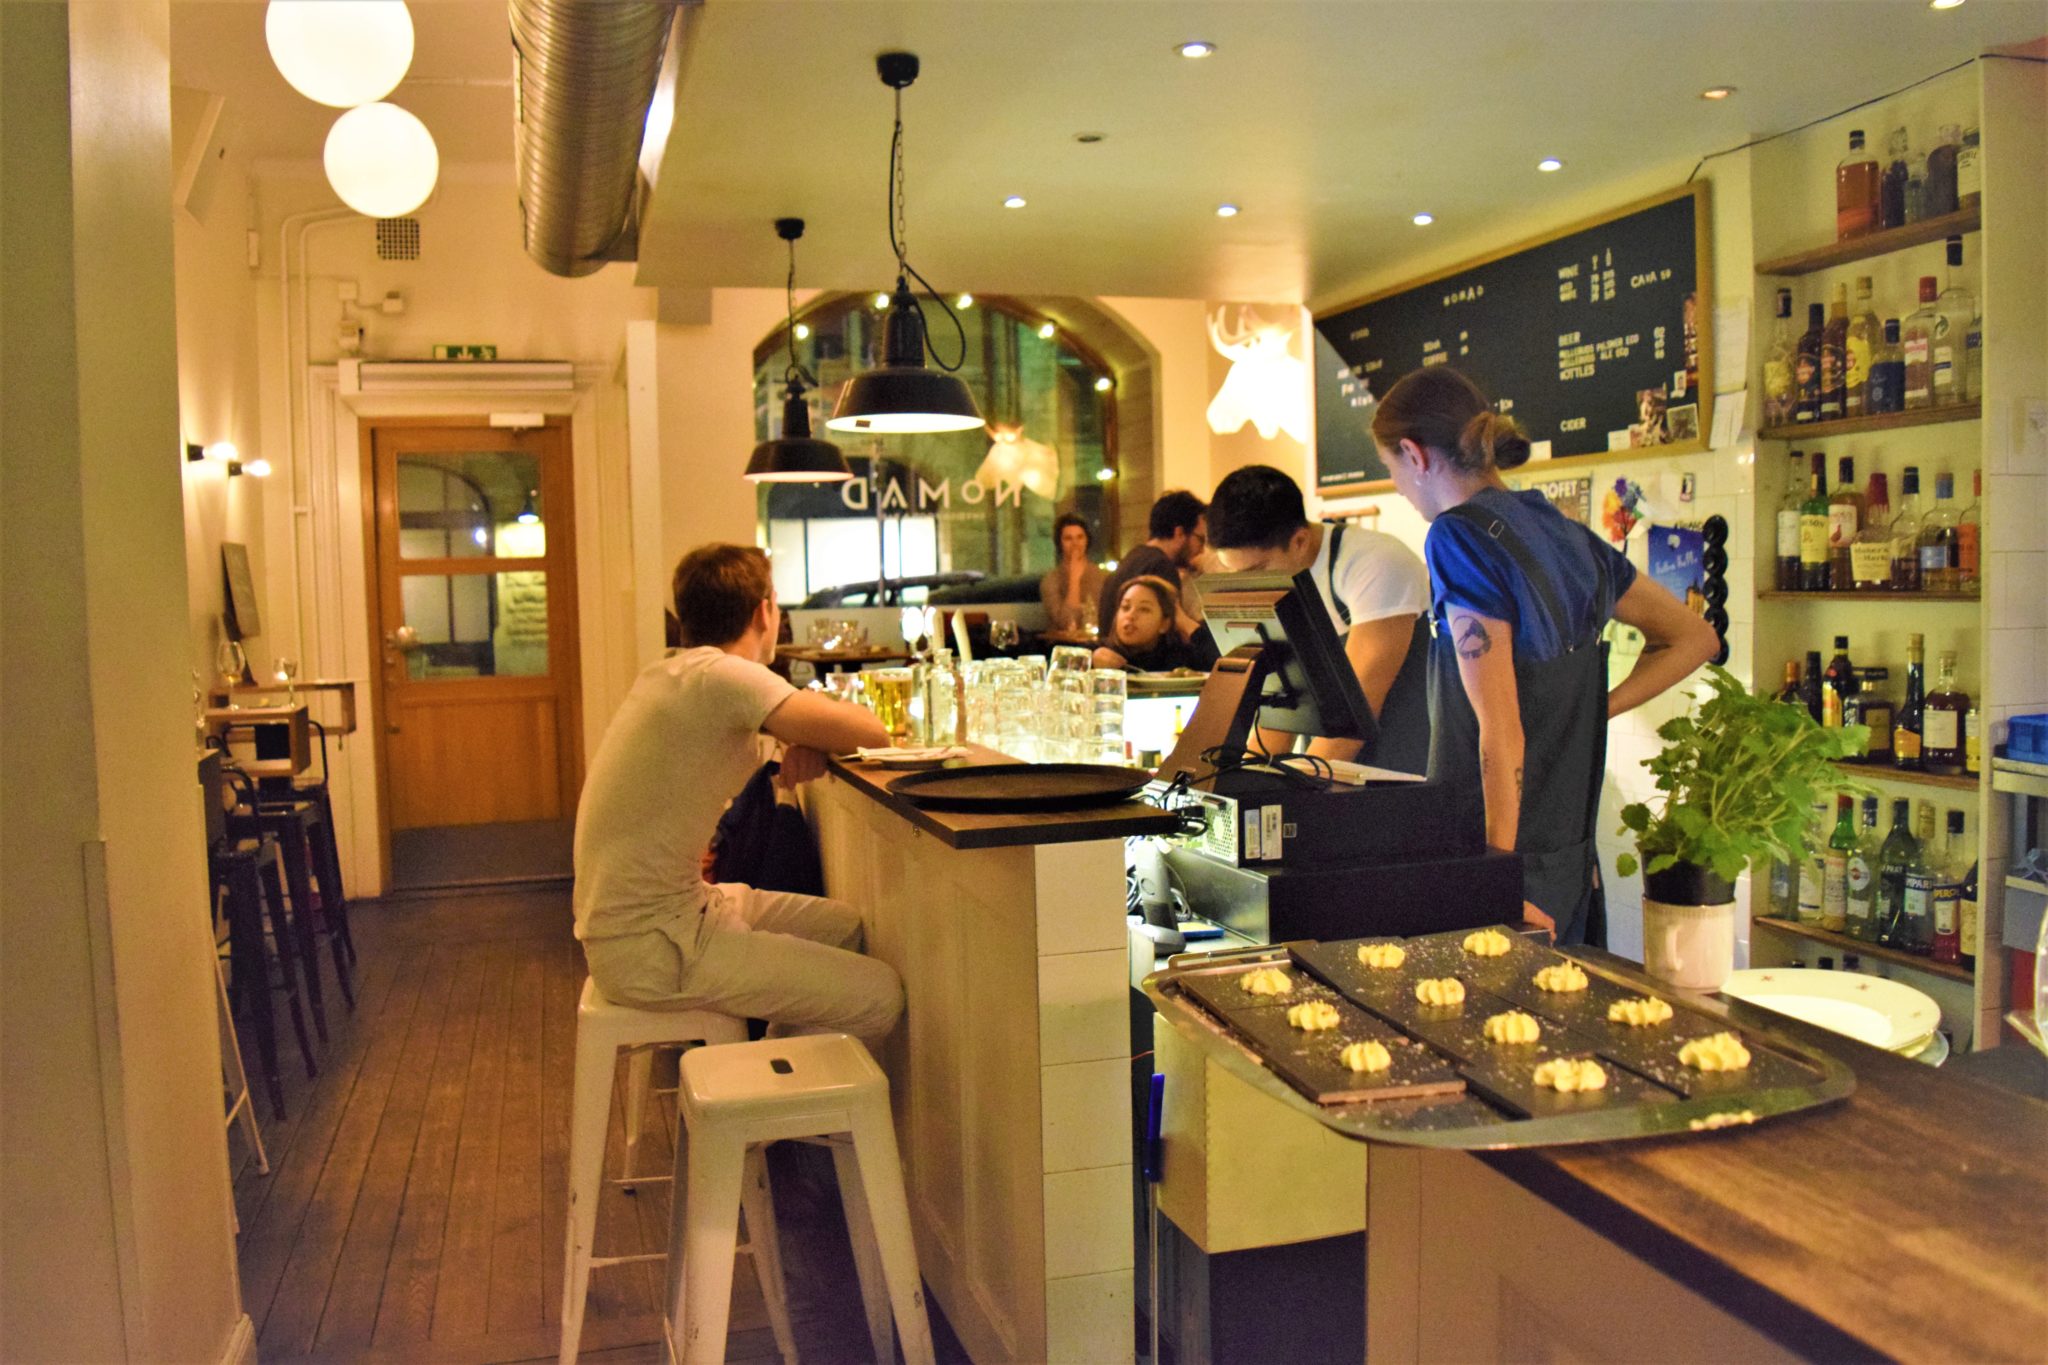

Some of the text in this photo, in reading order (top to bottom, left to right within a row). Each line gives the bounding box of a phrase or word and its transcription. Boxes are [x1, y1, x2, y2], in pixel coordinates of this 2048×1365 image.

[1630, 271, 1658, 289] CAVA
[1558, 331, 1581, 347] BEER
[1560, 363, 1596, 381] BOTTLES
[1560, 417, 1587, 432] CIDER
